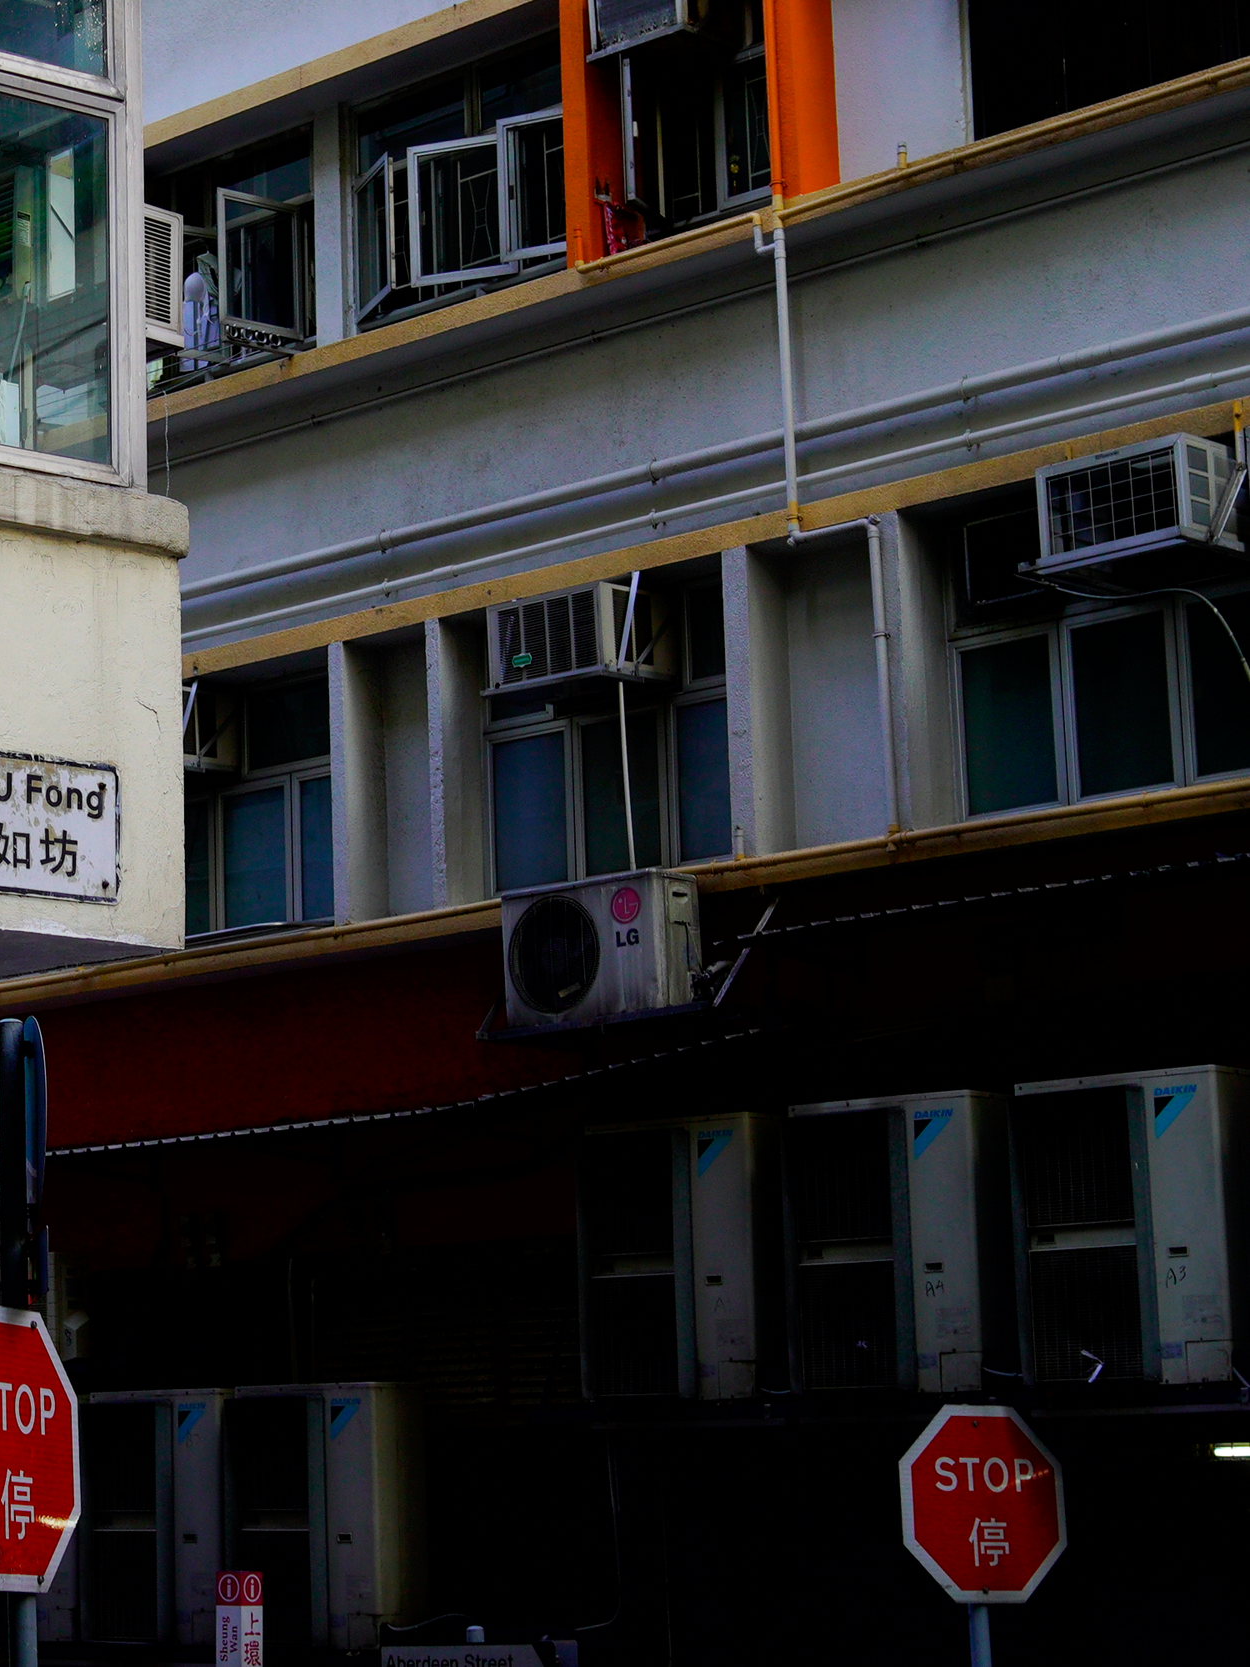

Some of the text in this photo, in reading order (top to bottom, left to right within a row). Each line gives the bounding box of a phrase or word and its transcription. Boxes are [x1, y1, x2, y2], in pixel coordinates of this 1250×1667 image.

[26, 773, 105, 819] Fong
[616, 928, 640, 947] LG
[1153, 1084, 1197, 1096] DAIKIN
[914, 1108, 954, 1119] DAIKIN
[934, 1456, 1035, 1493] STOP
[0, 1468, 36, 1541] 停
[968, 1517, 1010, 1567] 停
[219, 1615, 231, 1662] Sheung
[230, 1626, 238, 1653] Wan
[387, 1654, 514, 1667] Aberdeen Street
